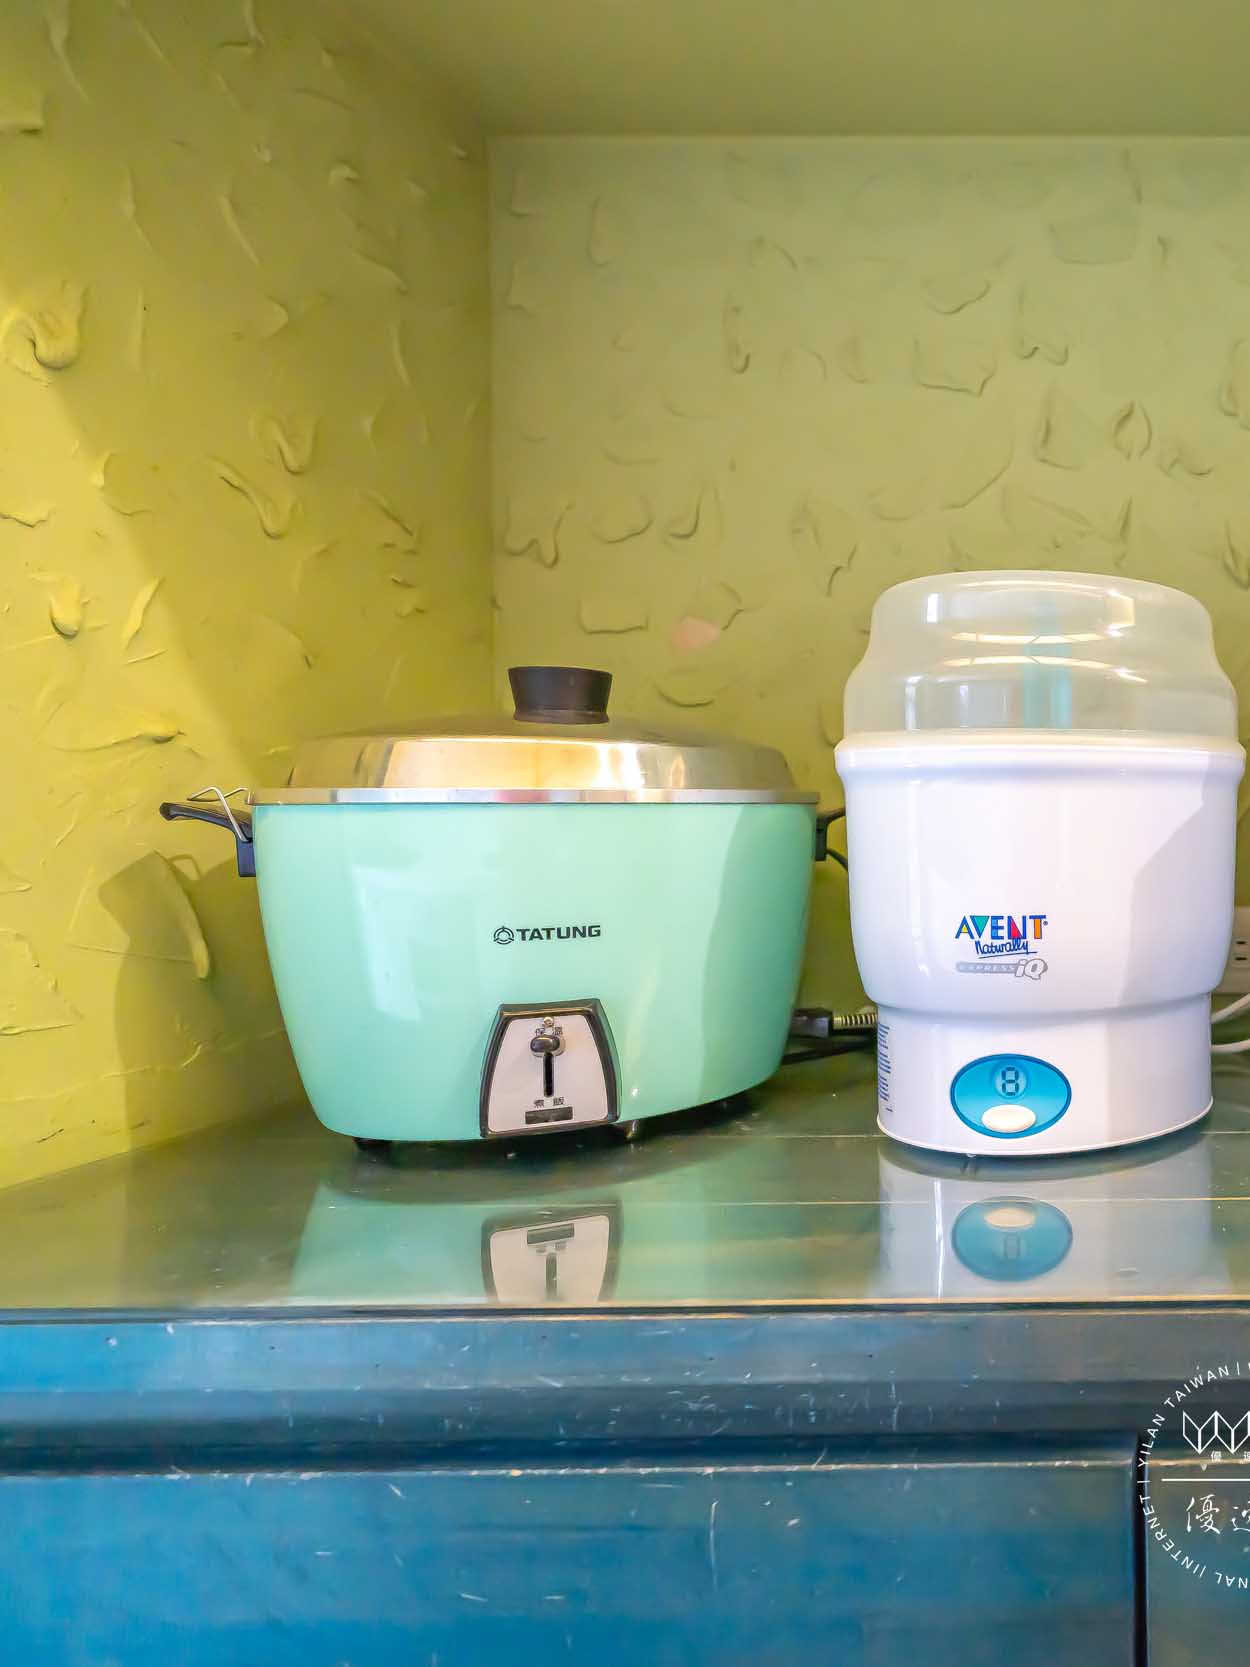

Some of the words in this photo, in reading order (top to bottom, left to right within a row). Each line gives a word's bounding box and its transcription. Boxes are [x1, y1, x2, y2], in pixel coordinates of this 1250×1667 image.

[516, 925, 601, 941] TATUNG
[955, 914, 1046, 940] AVENT
[974, 938, 1029, 955] Naturally
